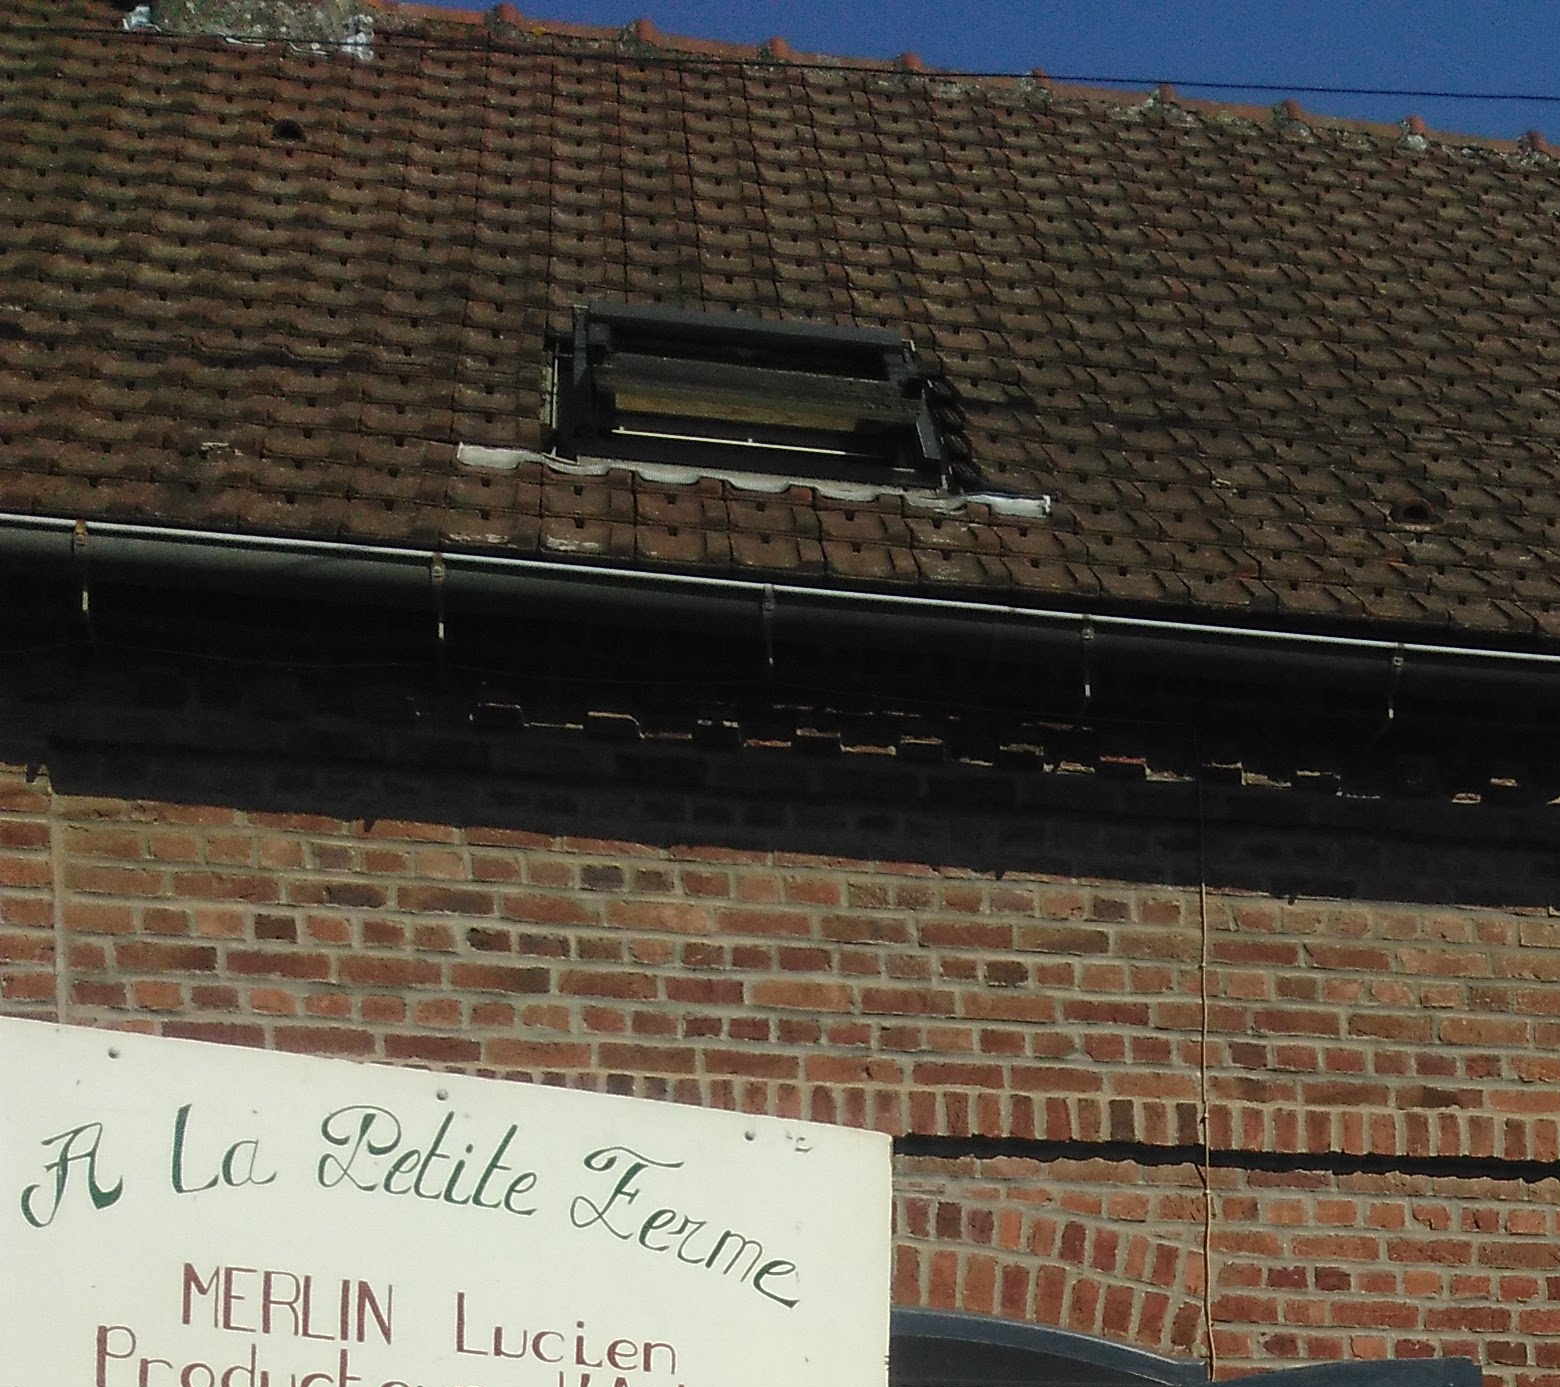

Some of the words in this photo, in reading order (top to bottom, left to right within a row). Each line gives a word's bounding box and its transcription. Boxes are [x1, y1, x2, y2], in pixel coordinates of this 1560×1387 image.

[22, 1122, 124, 1229] A
[172, 1104, 277, 1194] La
[317, 1104, 539, 1218] Petite
[570, 1145, 802, 1309] Ferme
[182, 1262, 393, 1345] MERLIN
[456, 1291, 678, 1375] Lucien
